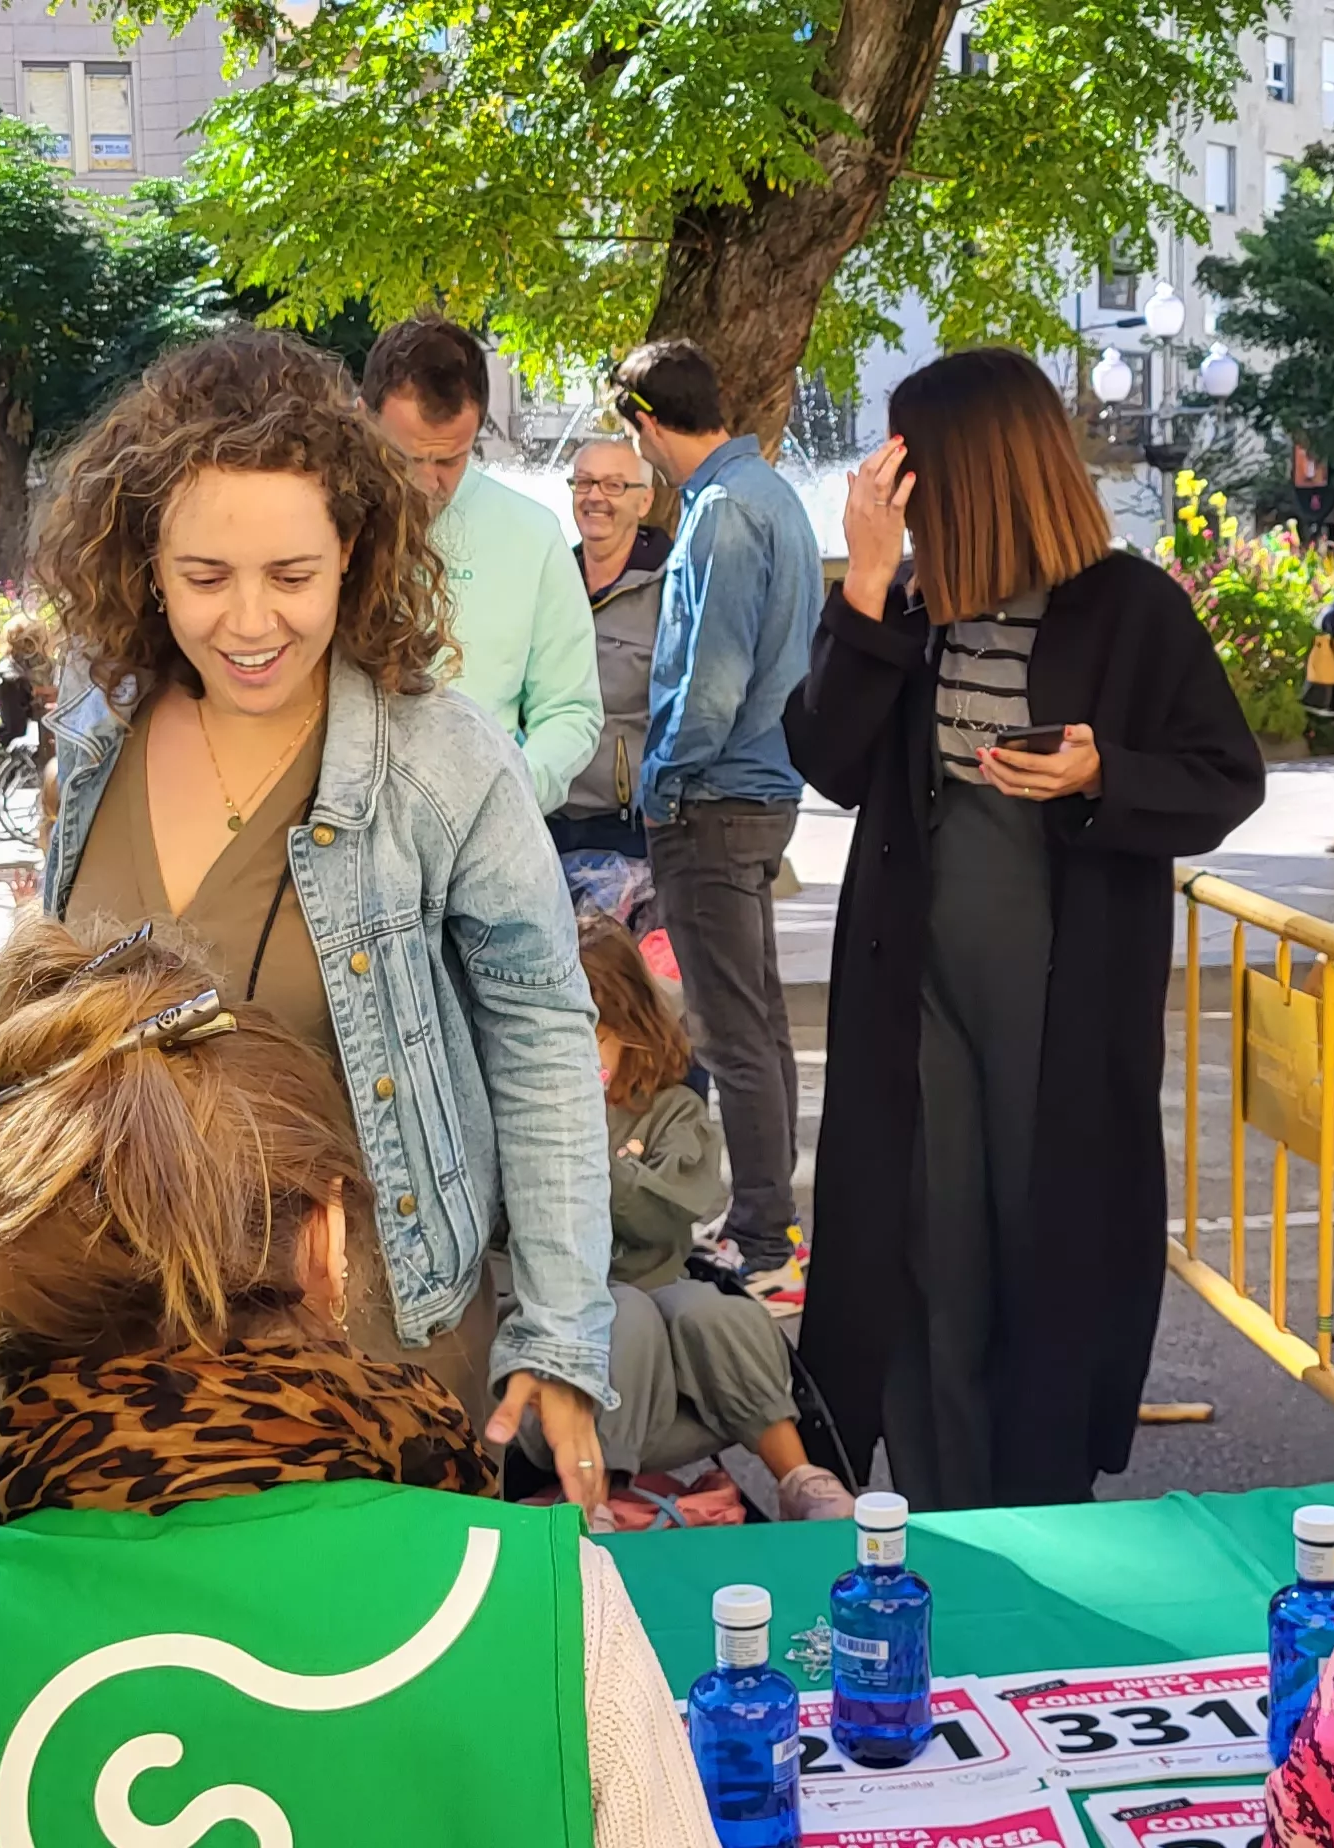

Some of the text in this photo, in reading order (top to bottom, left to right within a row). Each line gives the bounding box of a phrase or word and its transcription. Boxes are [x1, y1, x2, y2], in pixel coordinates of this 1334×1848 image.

[1112, 1674, 1195, 1690] HUESCA
[1027, 1688, 1144, 1708] CONTRA
[1147, 1685, 1181, 1697] EL
[1184, 1674, 1269, 1694] CÁNCE
[838, 1829, 932, 1844] HUESCA
